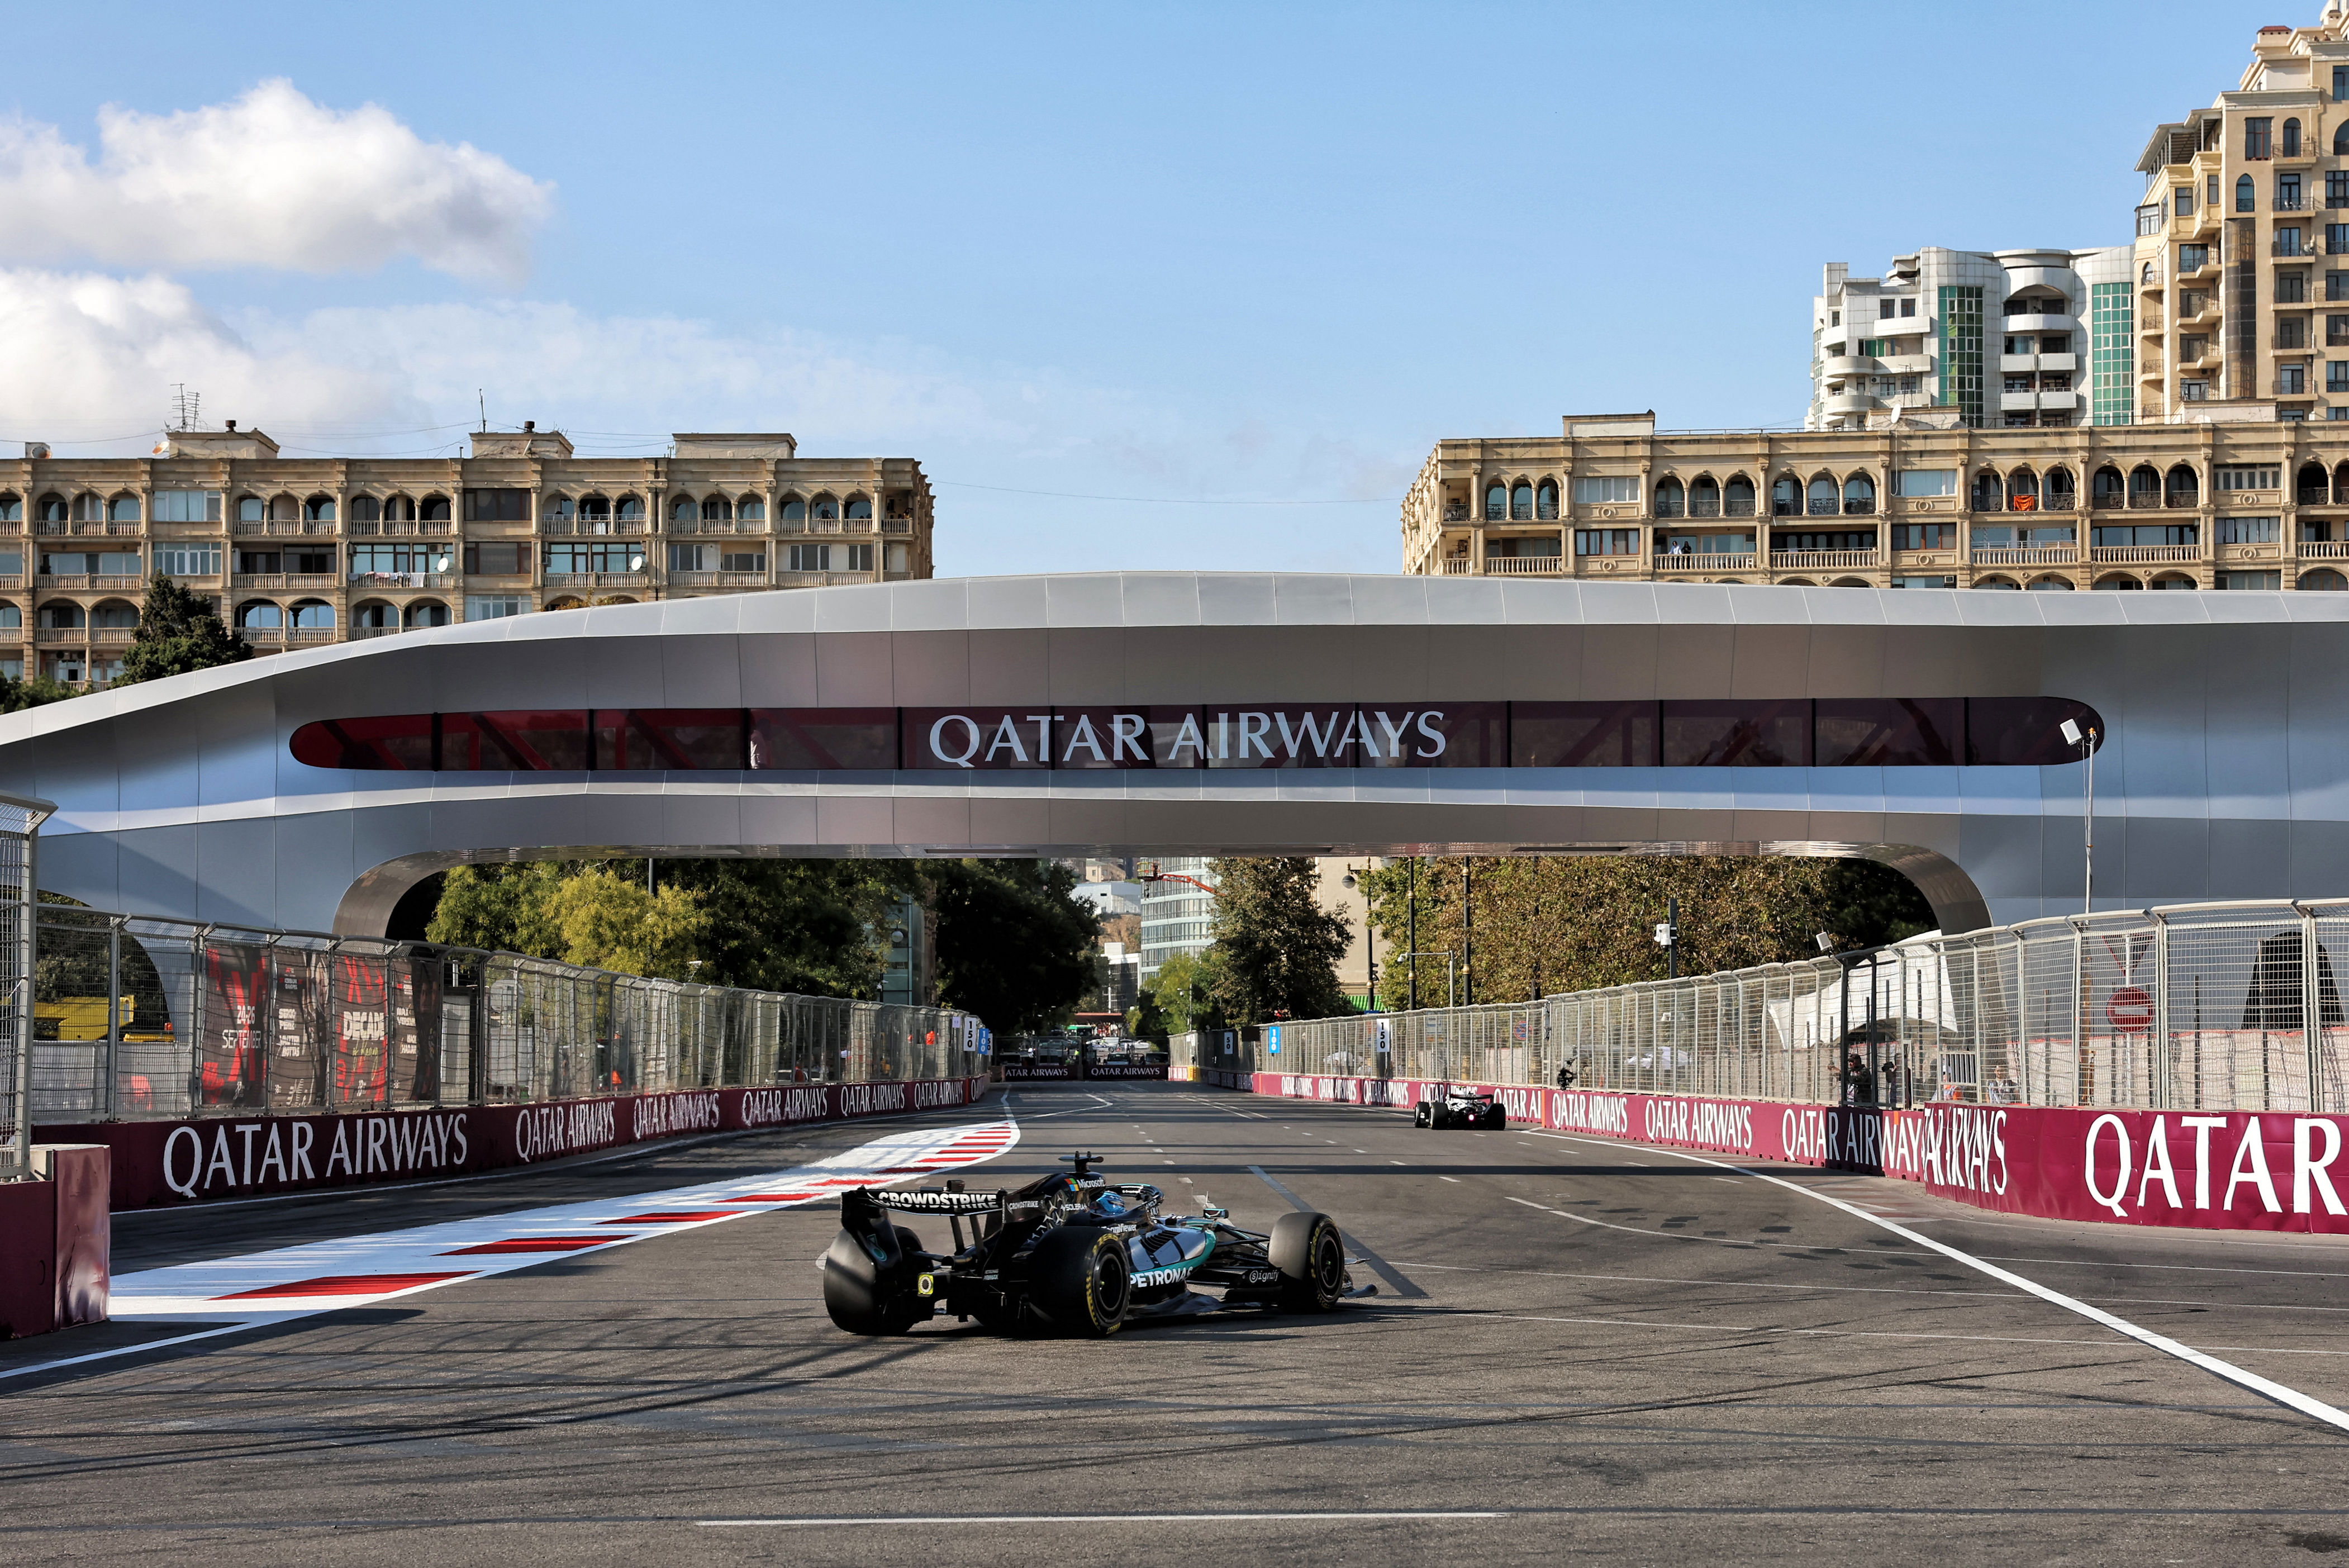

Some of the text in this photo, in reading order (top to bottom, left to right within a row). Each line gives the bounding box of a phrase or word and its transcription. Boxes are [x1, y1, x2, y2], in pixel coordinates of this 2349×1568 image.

[929, 710, 1446, 768] QATAR AIRWAYS
[222, 1029, 261, 1049] SEPTEMBER
[343, 1011, 385, 1040] DECADE
[987, 1038, 991, 1051] 50
[1226, 1037, 1230, 1049] 50
[1006, 1068, 1068, 1077] ATAR AIRWAYS
[1091, 1068, 1121, 1076] QATAR
[1123, 1067, 1160, 1076] AIRWAYS
[840, 1083, 905, 1117] QATAR AIRWAYS
[914, 1081, 938, 1110] QATAR
[938, 1080, 963, 1106] AIRWAYS
[1318, 1078, 1334, 1100] QATAR
[1363, 1080, 1409, 1105] QATAR AIRWAYS
[1420, 1083, 1444, 1104] QATAR
[1494, 1088, 1527, 1118] QATAR
[634, 1092, 720, 1139] QATAR AIRWAYS
[742, 1087, 828, 1127] QATAR AIRWAYS
[1552, 1092, 1628, 1133] QATAR AIRWAYS
[516, 1101, 615, 1162] QATAR AIRWAYS
[1645, 1099, 1752, 1149] QATAR AIRWAYS
[1782, 1108, 1922, 1172] QATAR AIRWAY
[163, 1113, 468, 1198] QATAR AIRWAYS
[2085, 1113, 2348, 1217] QATAR
[1077, 1177, 1105, 1189] Microsoft
[878, 1192, 999, 1209] CROWDSTRIKE
[1009, 1200, 1039, 1210] CROWDSTRIKE
[1249, 1270, 1280, 1283] signify
